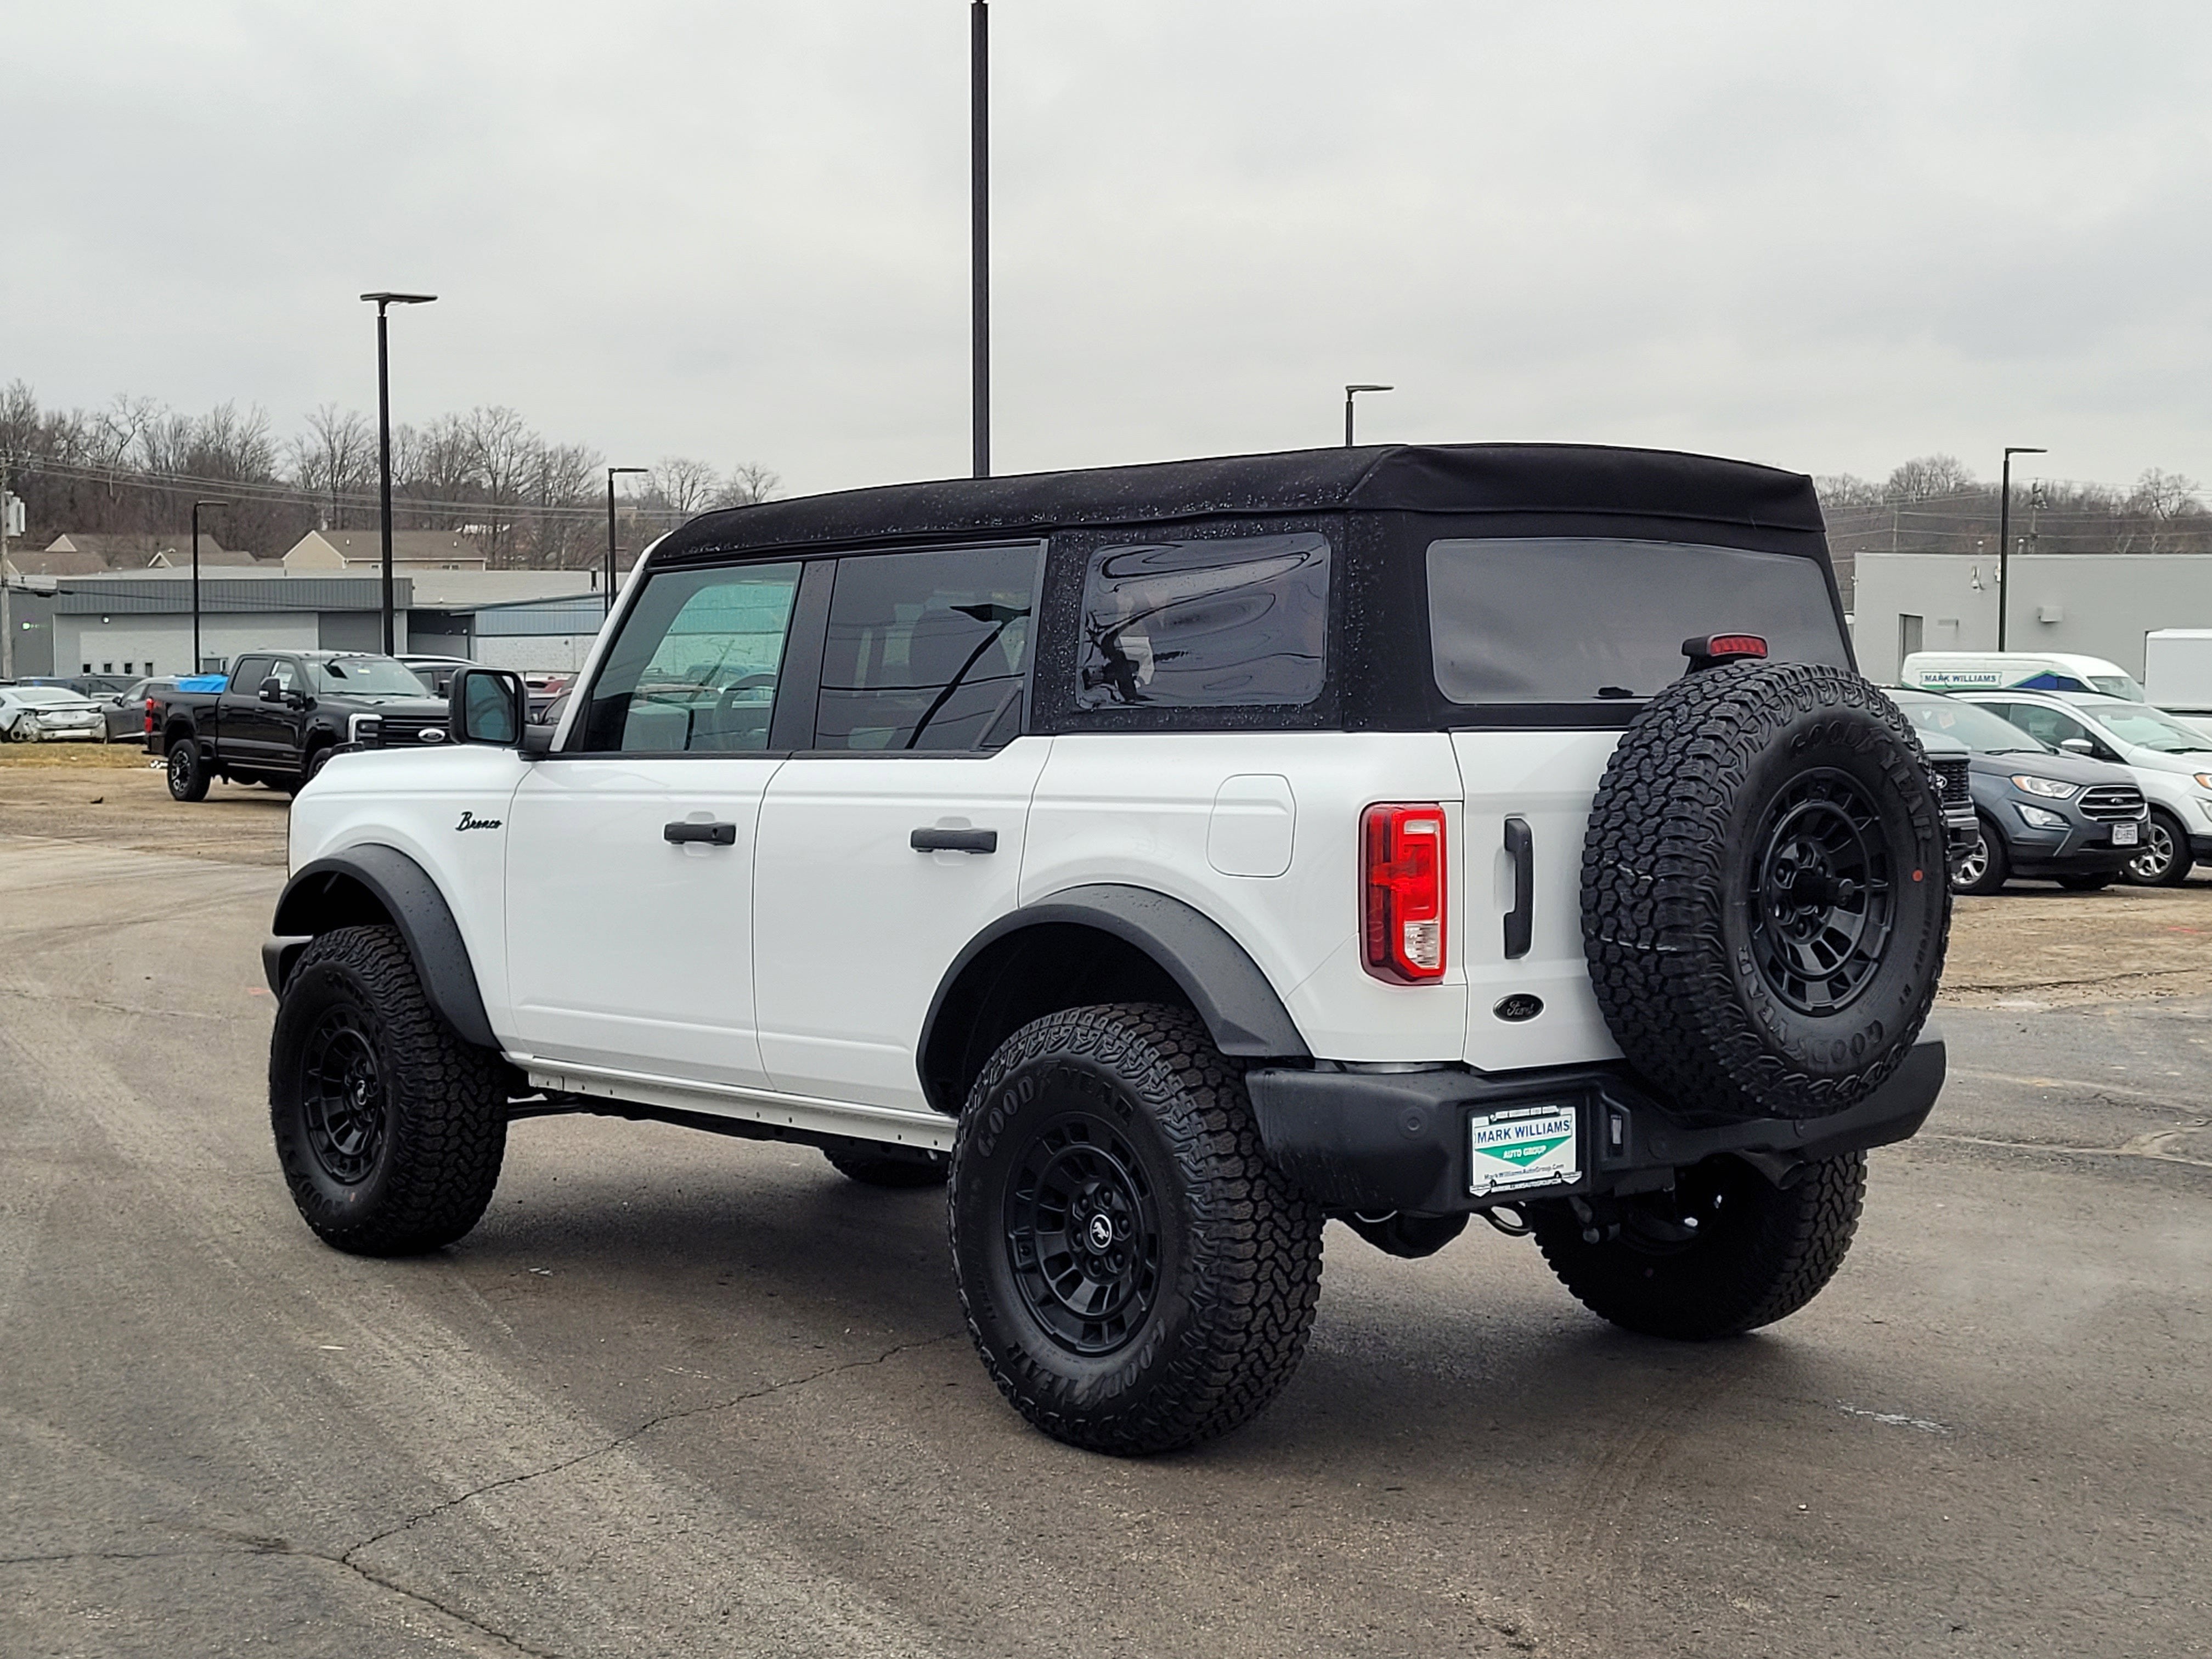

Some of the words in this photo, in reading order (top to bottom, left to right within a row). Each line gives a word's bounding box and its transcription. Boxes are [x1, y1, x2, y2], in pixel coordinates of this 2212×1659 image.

[455, 811, 503, 832] Bronco
[1506, 1001, 1534, 1017] Ford
[1477, 1128, 1511, 1143] MARK
[1515, 1120, 1570, 1138] WILLIAMS
[1503, 1149, 1522, 1159] AUTO
[1523, 1145, 1547, 1156] GROUP
